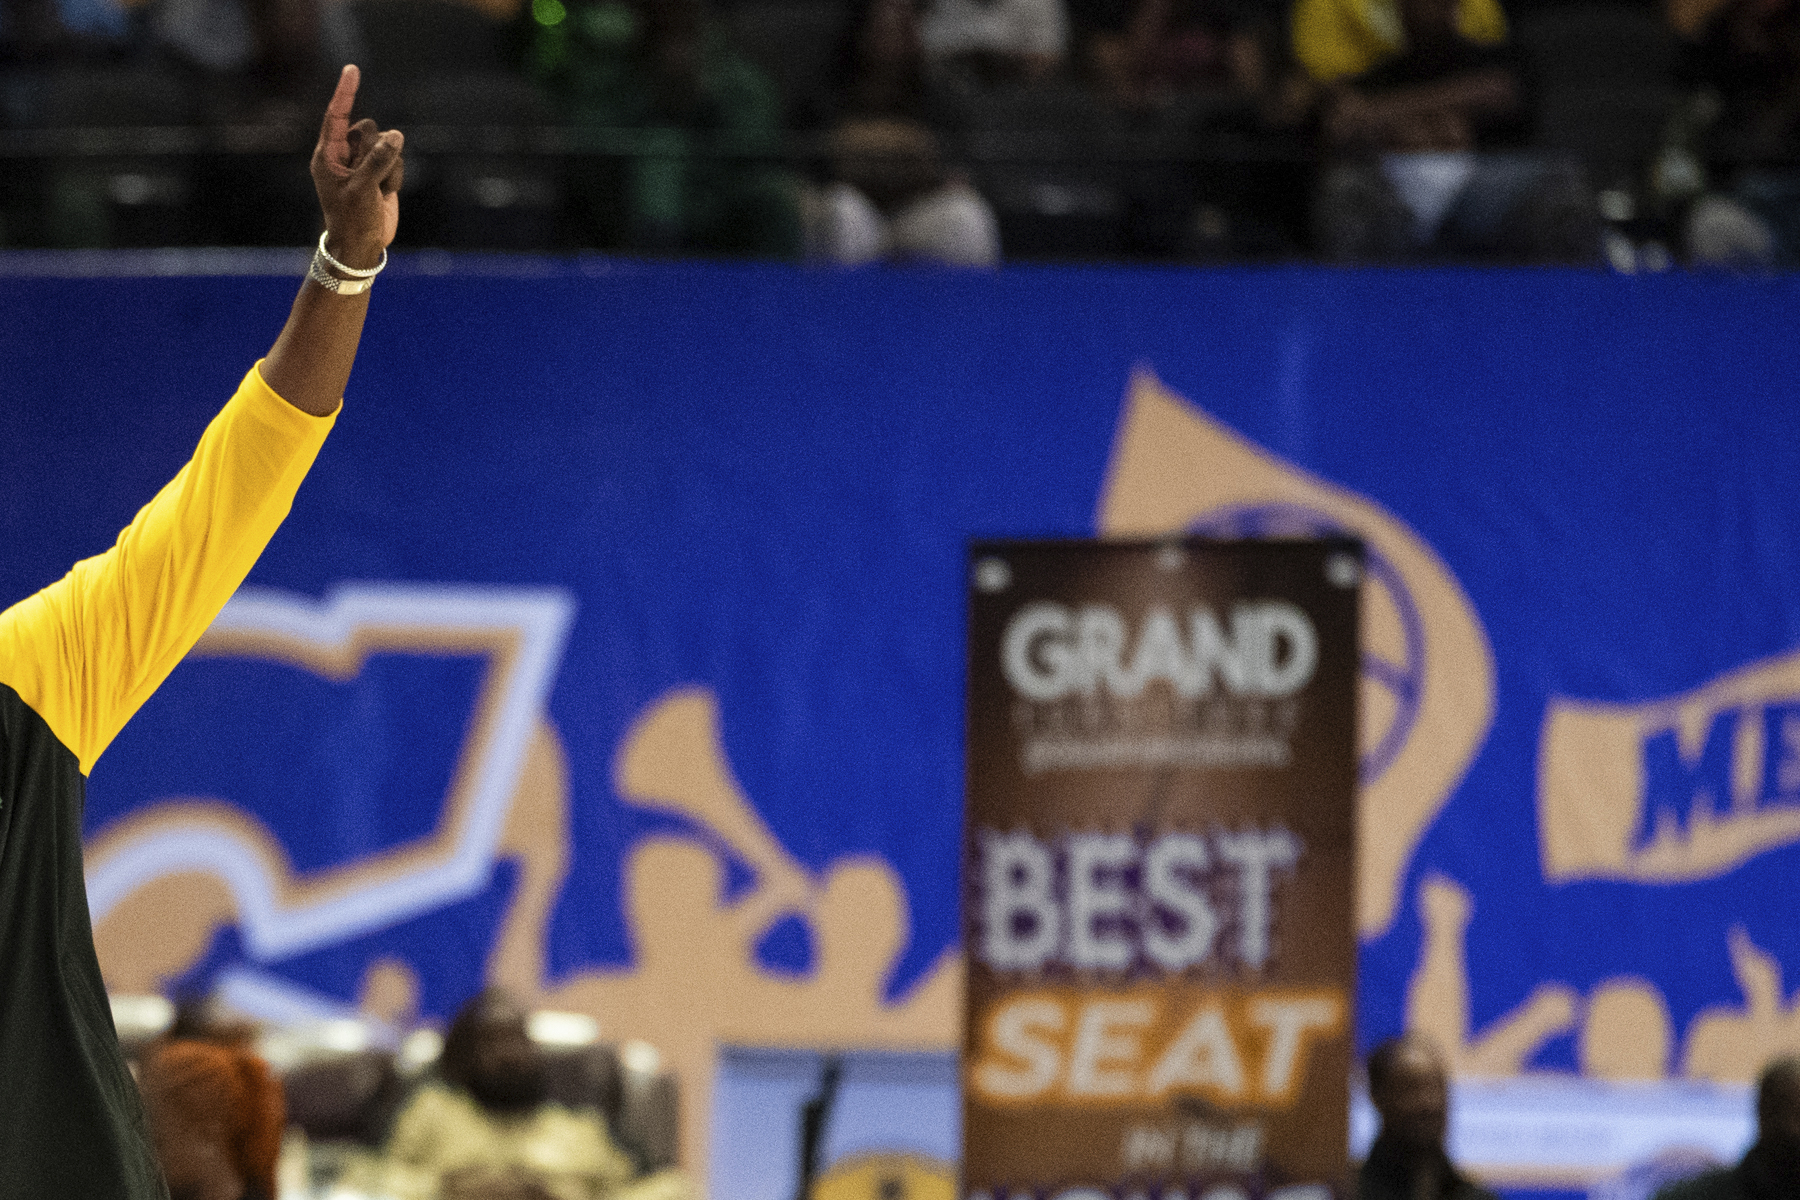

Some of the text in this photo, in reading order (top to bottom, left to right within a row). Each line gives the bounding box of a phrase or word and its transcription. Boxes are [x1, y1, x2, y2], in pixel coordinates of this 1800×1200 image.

[1003, 602, 1315, 700] GRAND
[982, 830, 1298, 970] BEST
[974, 990, 1350, 1102] SEAT
[1121, 1124, 1264, 1168] IN THE
